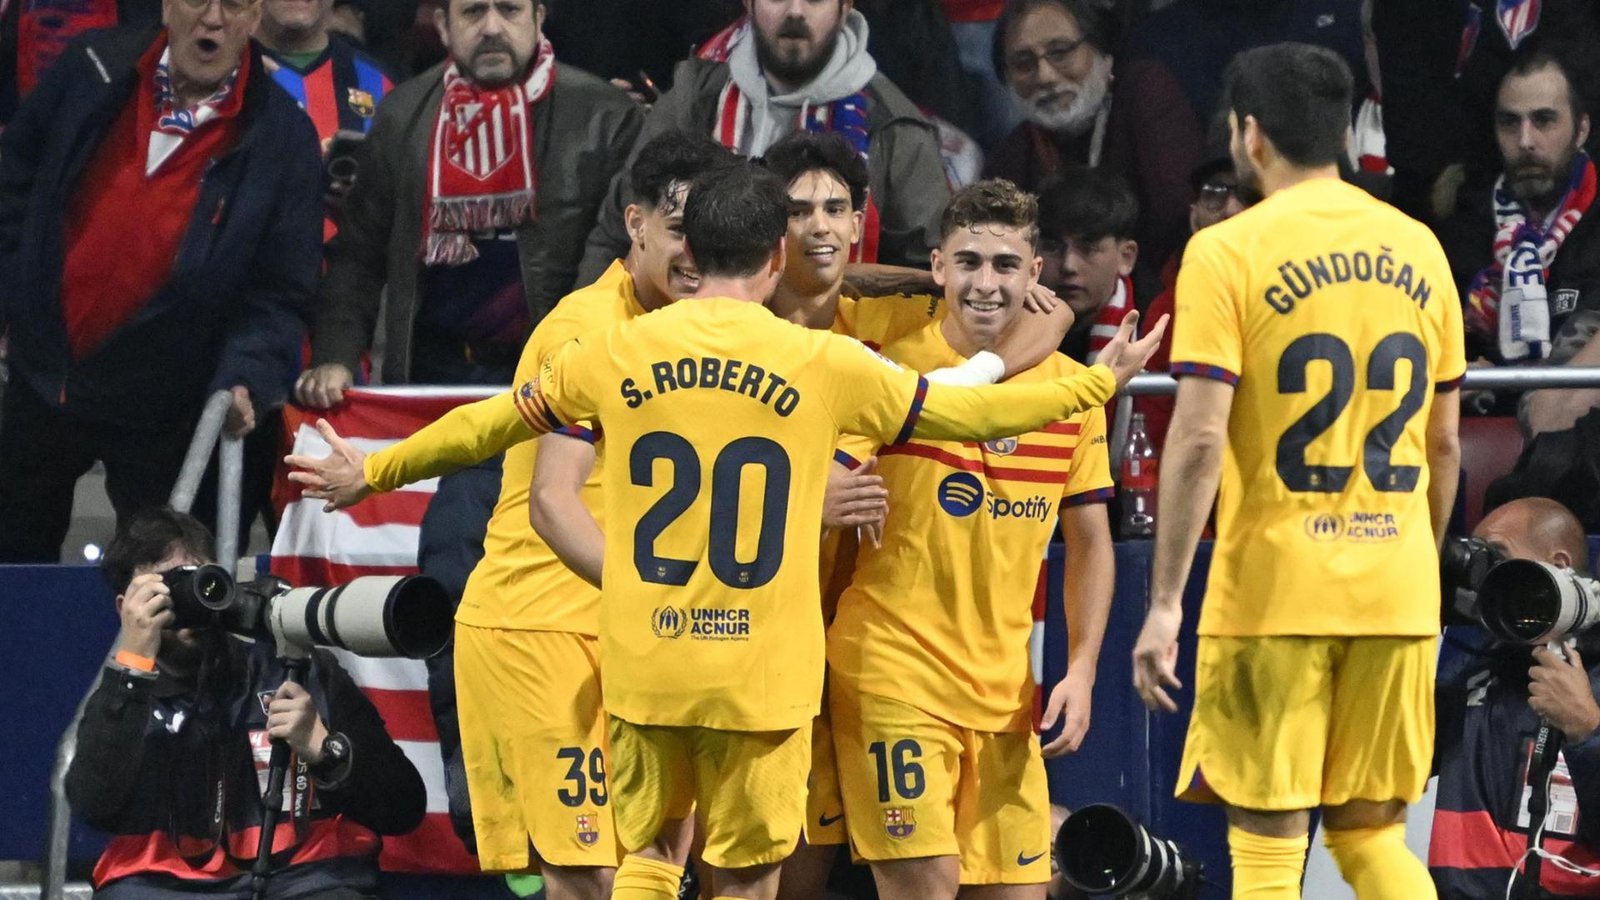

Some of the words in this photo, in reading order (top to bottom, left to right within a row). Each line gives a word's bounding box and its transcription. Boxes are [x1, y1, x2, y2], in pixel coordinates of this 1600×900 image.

[1264, 245, 1431, 314] GÜNDOĞAN
[620, 378, 653, 408] S.
[651, 357, 800, 417] ROBERTO
[1276, 332, 1428, 493] 22
[629, 431, 791, 590] 20
[986, 491, 1052, 523] Spotify
[690, 608, 750, 622] UNHCR
[690, 621, 750, 635] ACNUR
[1534, 726, 1549, 755] SIRUI
[556, 747, 608, 807] 39
[868, 739, 926, 803] 16
